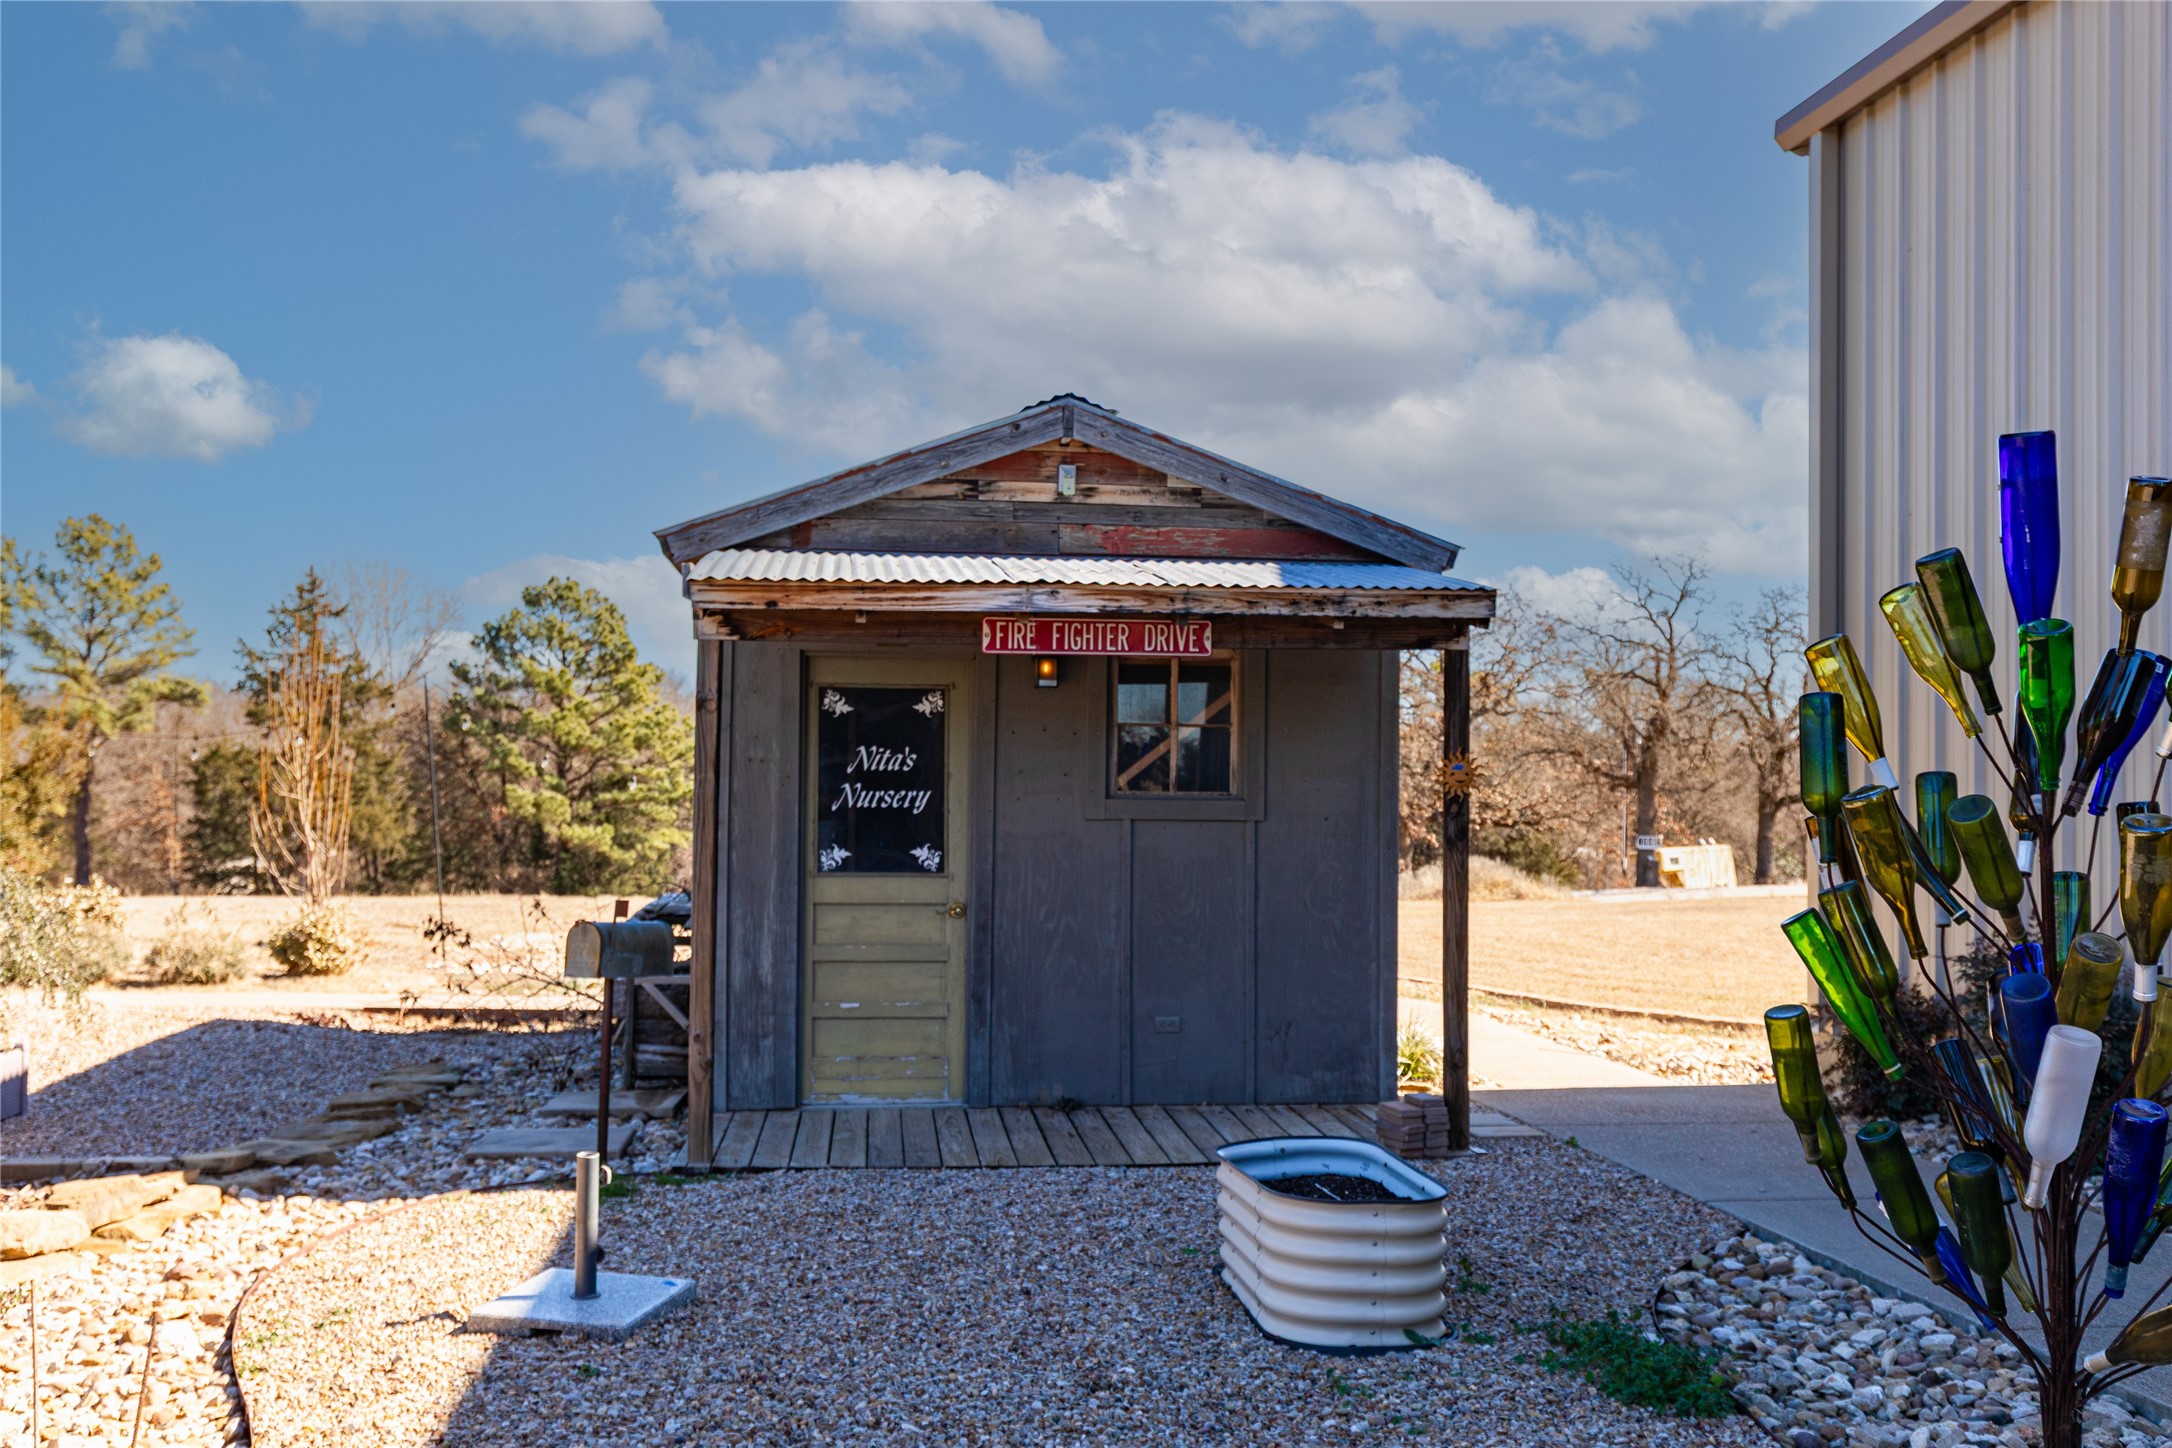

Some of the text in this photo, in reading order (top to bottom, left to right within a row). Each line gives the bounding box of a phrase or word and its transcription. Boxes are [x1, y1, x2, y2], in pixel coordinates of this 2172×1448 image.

[996, 622, 1200, 652] FIRE FIGHTER DRIVE
[846, 745, 918, 775] Nita's
[831, 782, 932, 815] Nursery
